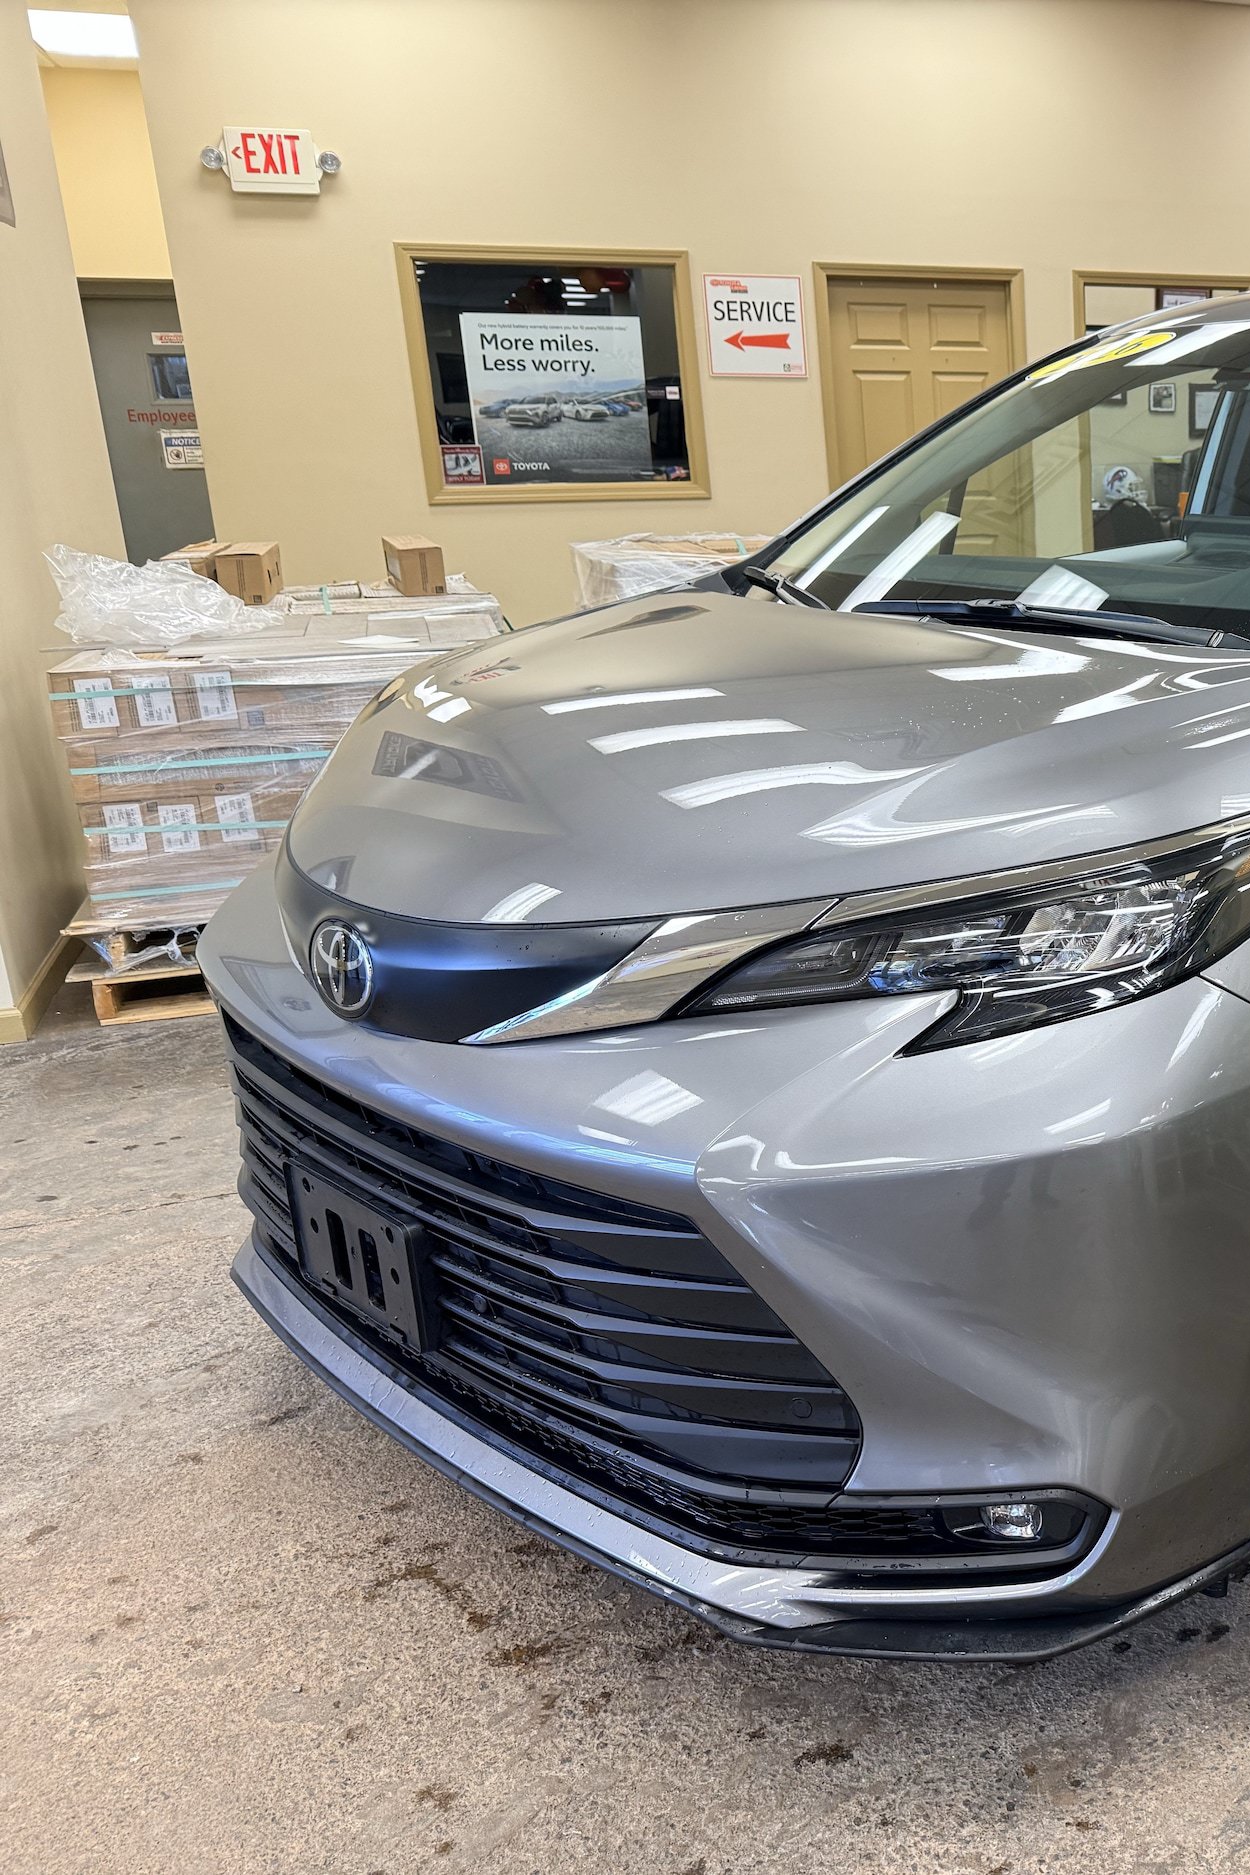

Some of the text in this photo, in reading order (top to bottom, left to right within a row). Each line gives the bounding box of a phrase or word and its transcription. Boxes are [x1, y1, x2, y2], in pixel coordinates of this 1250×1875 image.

[241, 133, 300, 175] EXIT
[713, 299, 796, 322] SERVICE
[480, 333, 599, 352] More miles.
[482, 354, 596, 376] Less worry.
[127, 409, 196, 425] Employee
[512, 462, 551, 472] TOYOTA
